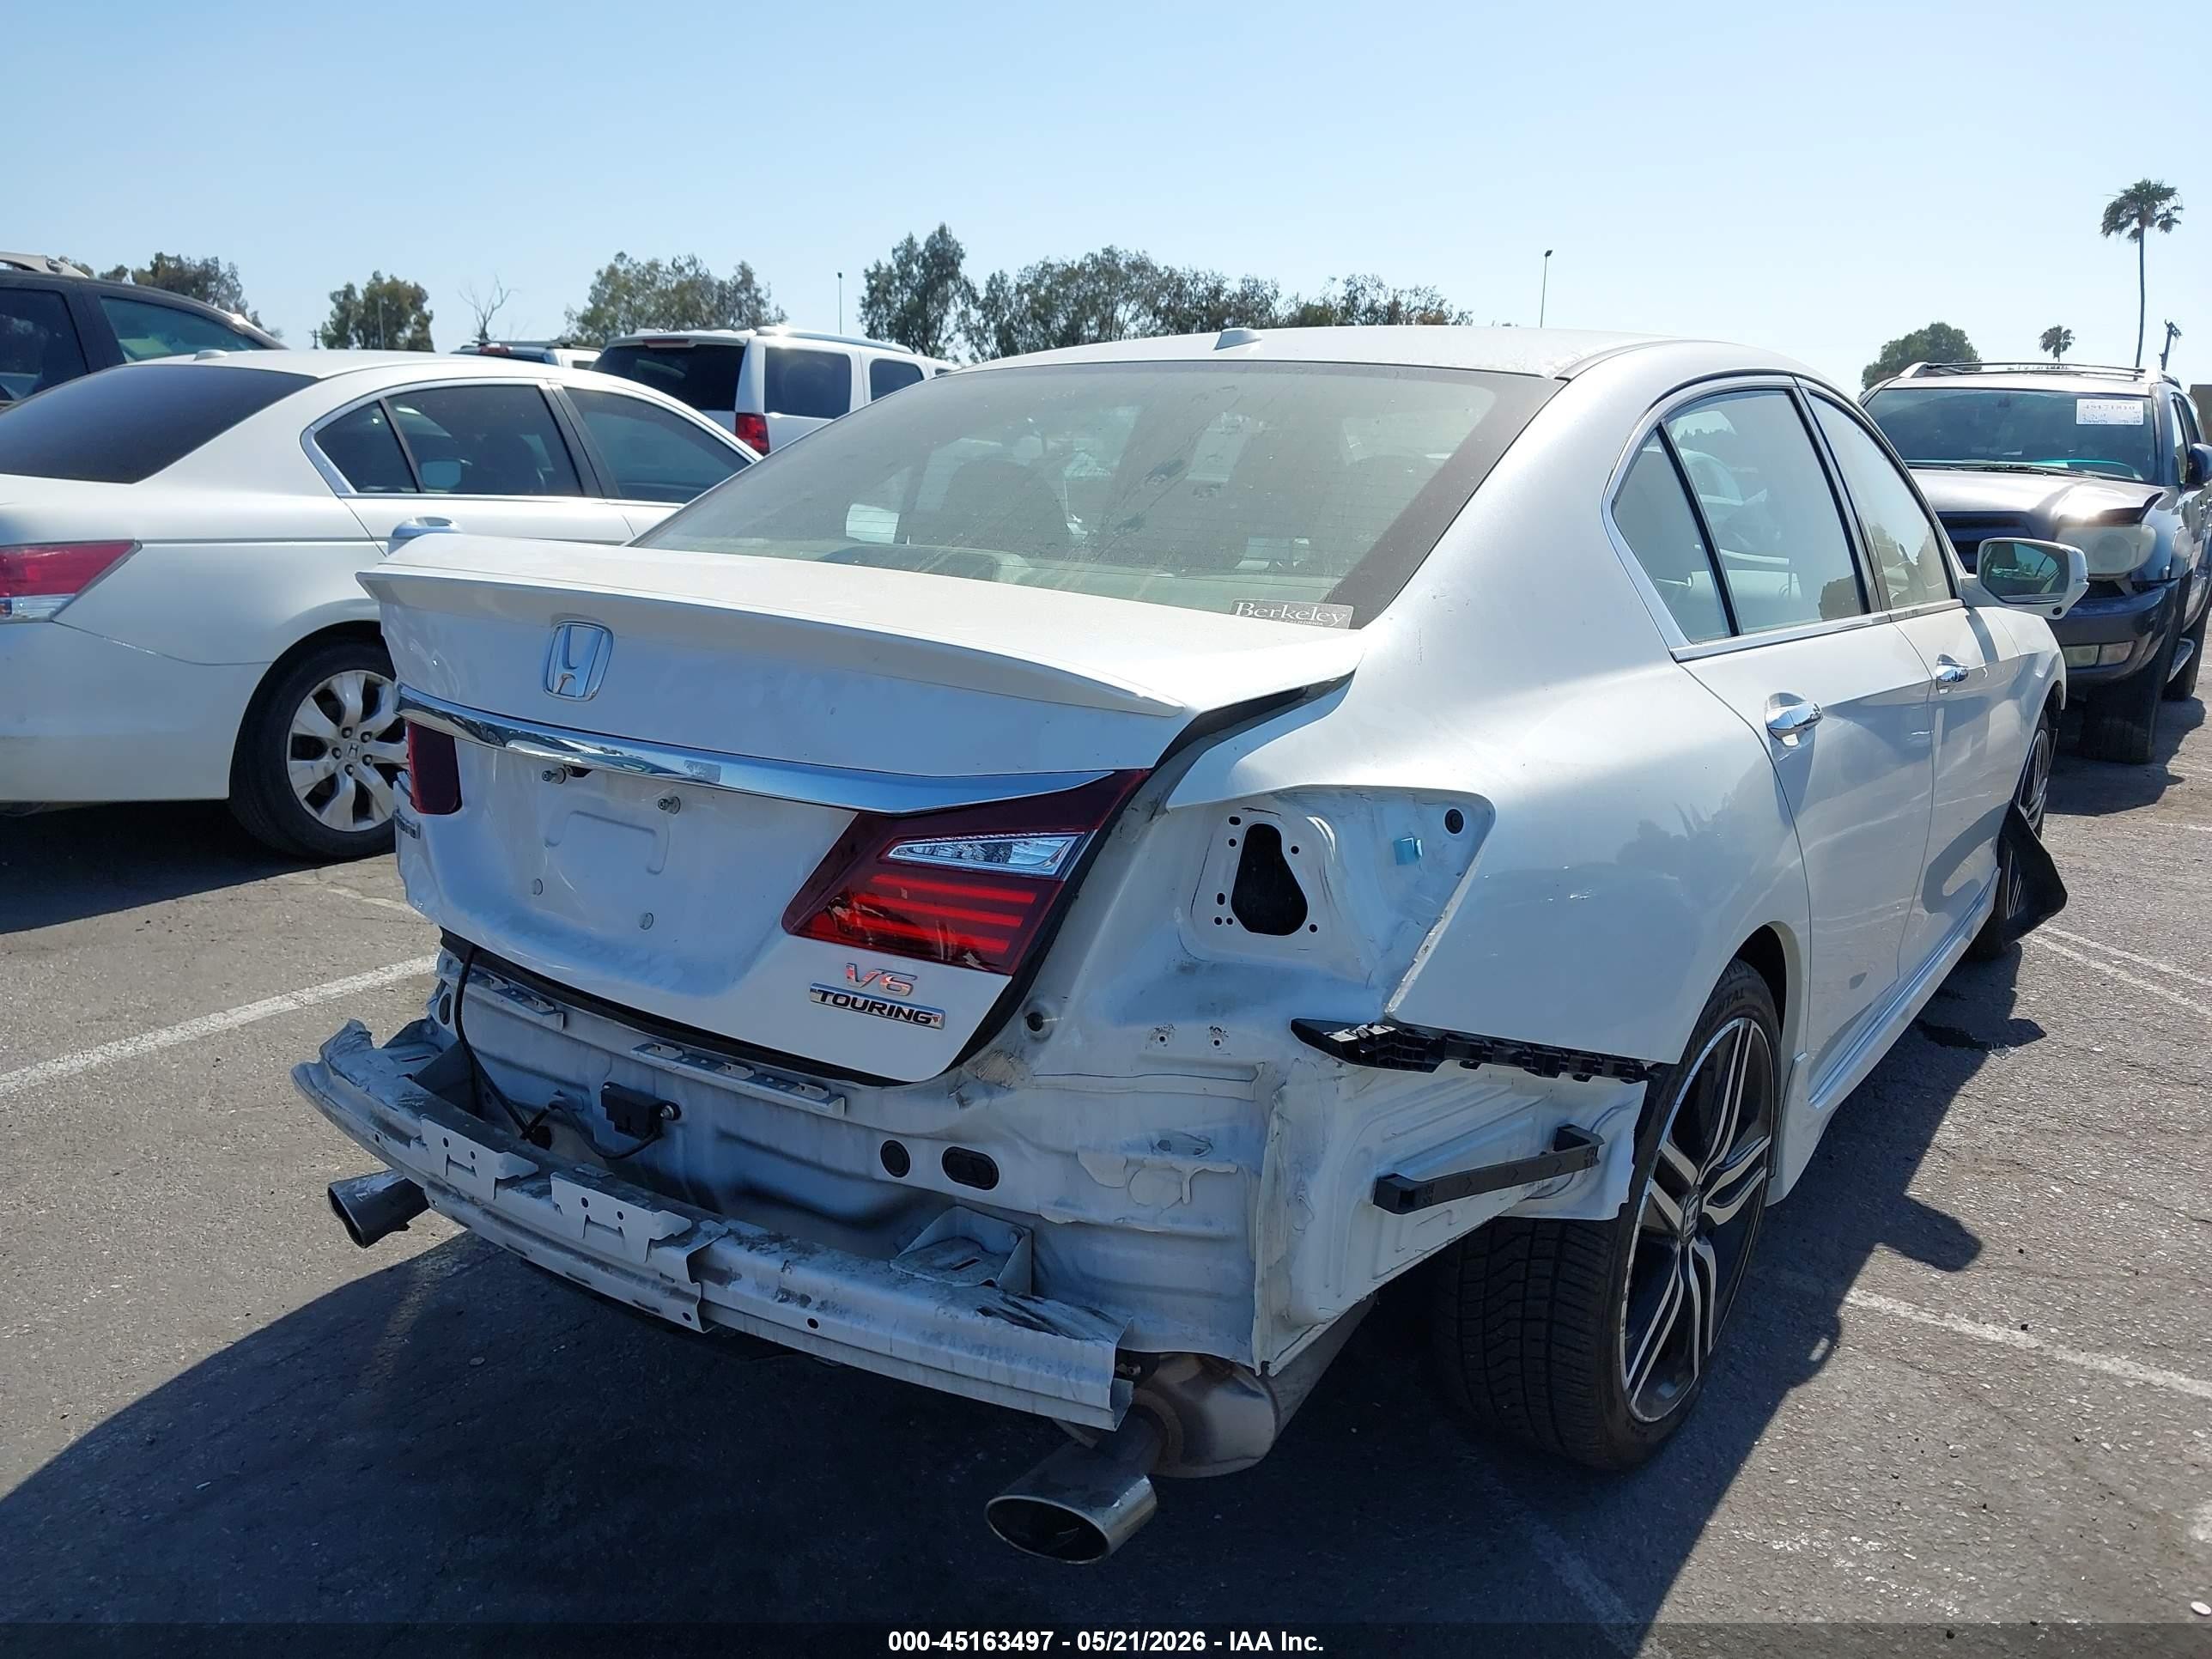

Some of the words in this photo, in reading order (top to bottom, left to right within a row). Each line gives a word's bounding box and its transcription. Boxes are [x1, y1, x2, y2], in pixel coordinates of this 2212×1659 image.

[1235, 602, 1347, 626] Berkeley
[845, 963, 918, 996] V6
[817, 989, 934, 1024] TOURING
